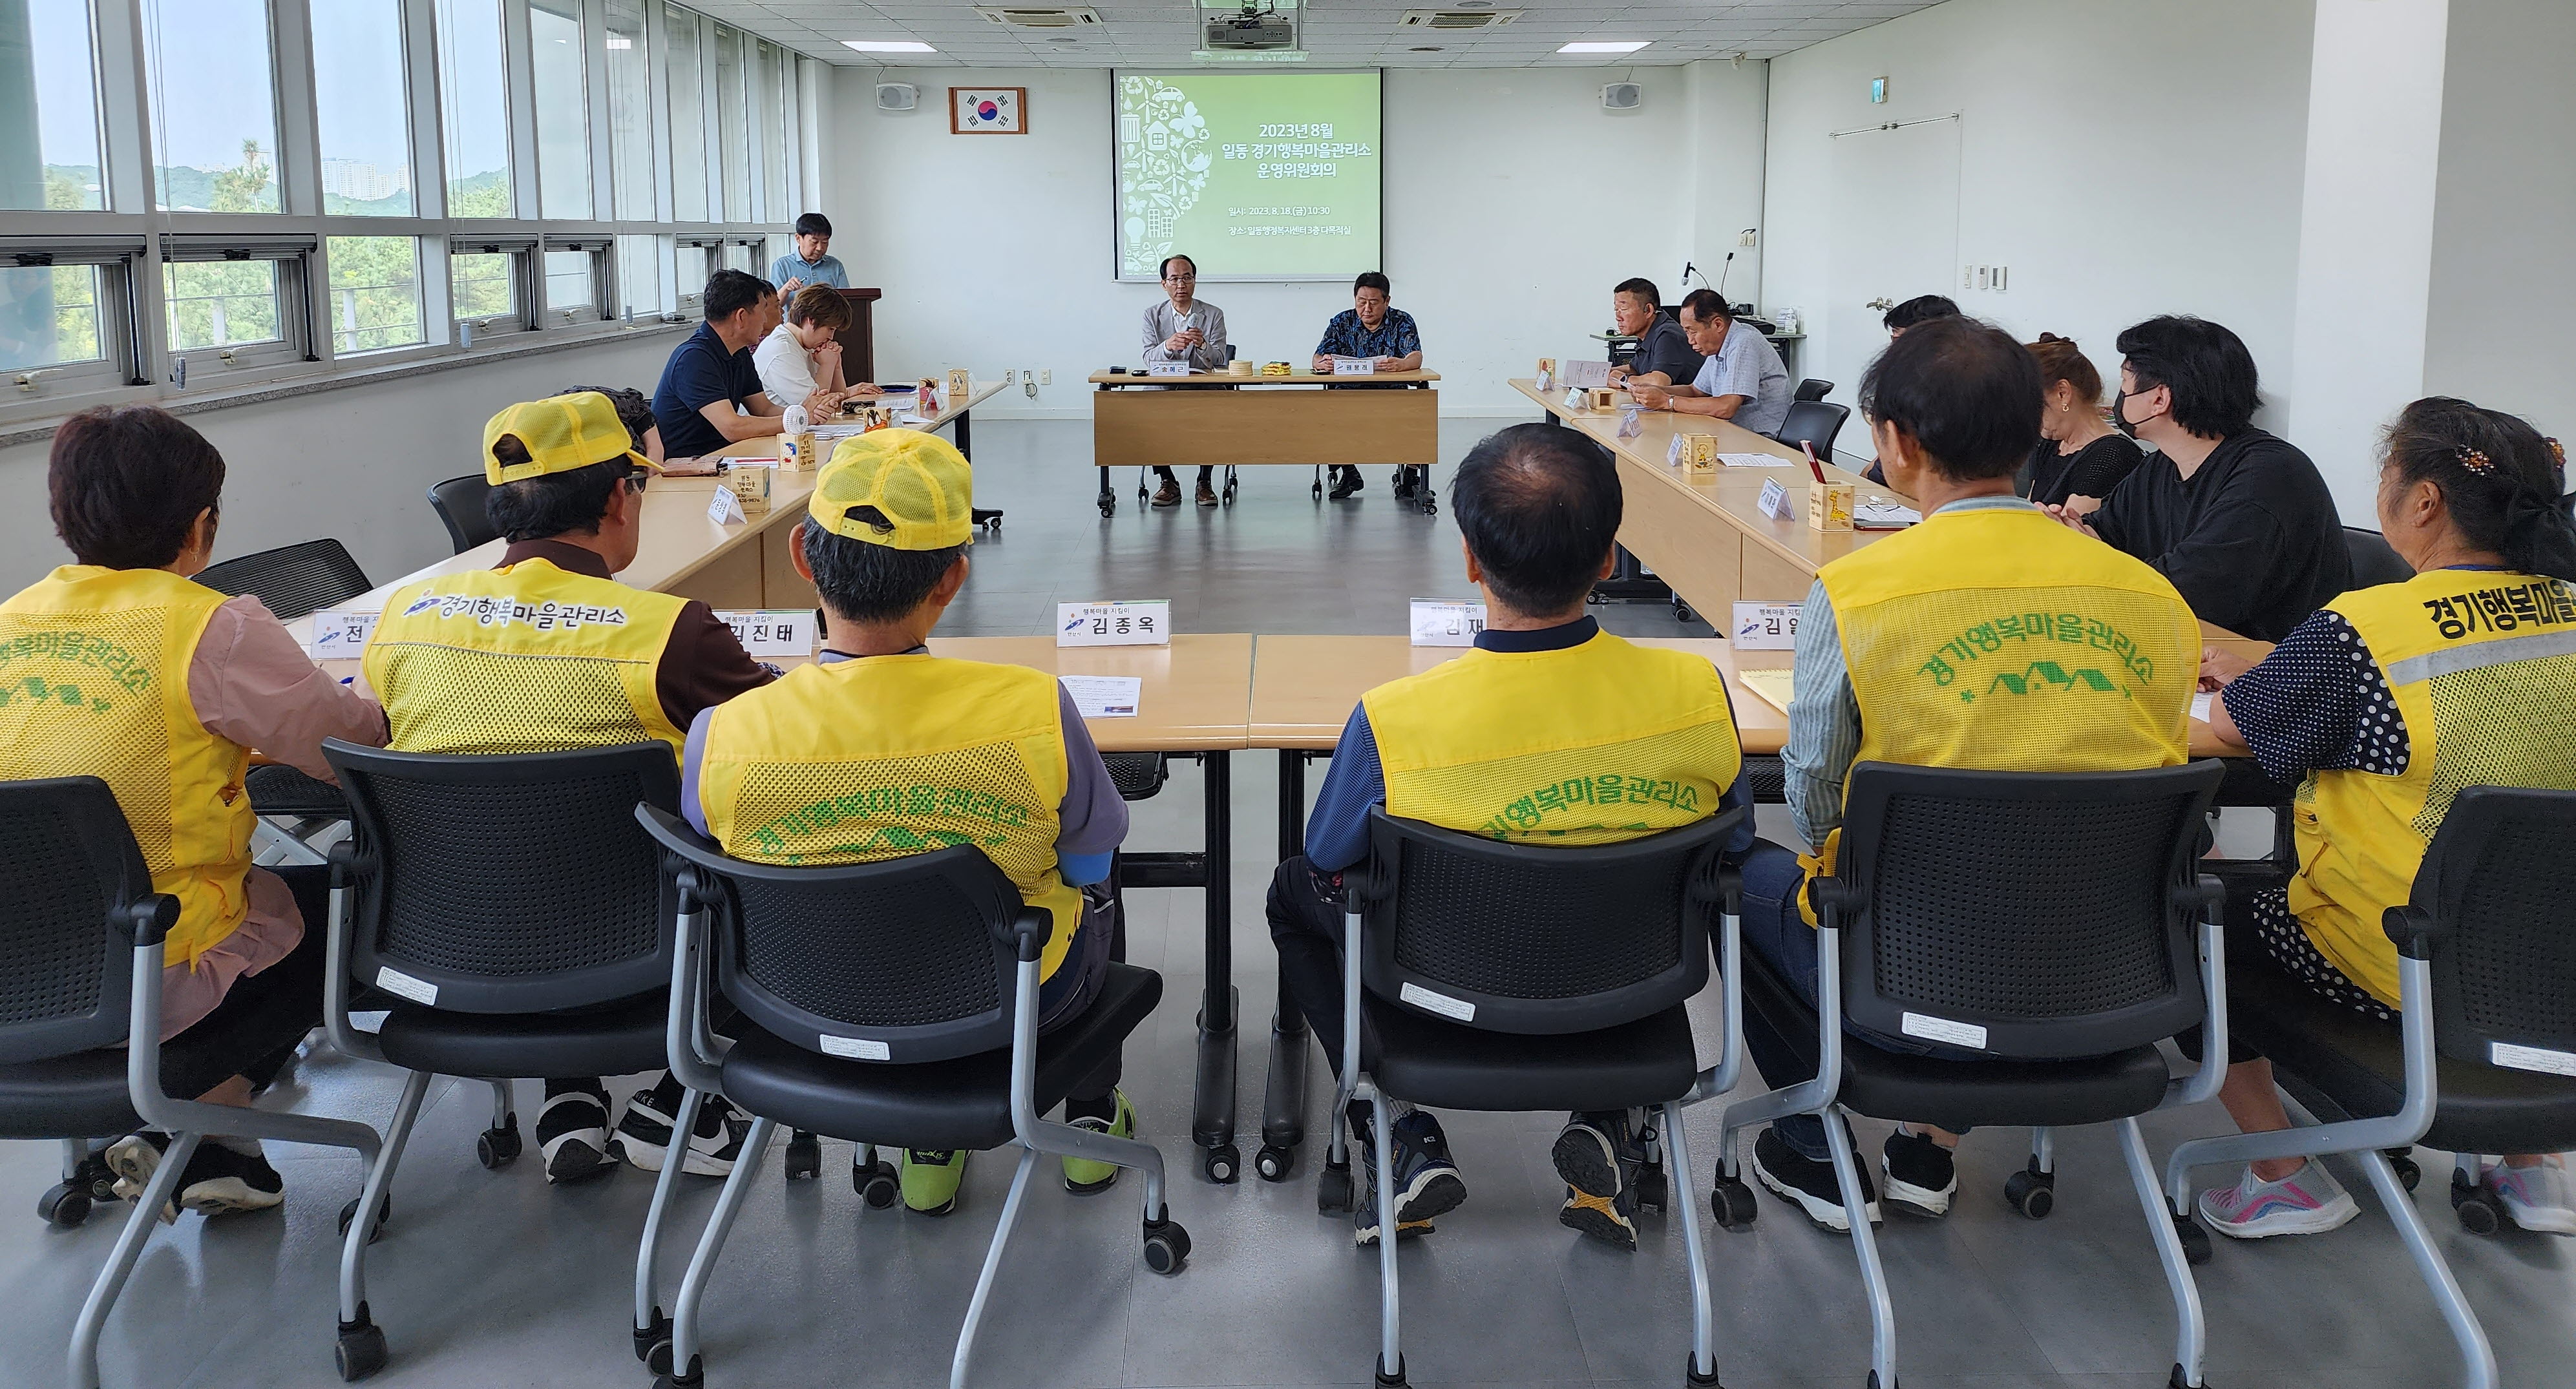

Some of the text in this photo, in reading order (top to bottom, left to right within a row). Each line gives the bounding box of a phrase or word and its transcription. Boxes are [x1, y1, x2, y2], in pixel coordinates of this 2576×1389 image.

[1258, 123, 1333, 140] 2023년 8월
[1221, 143, 1372, 160] 일동 경기행복마을관리소
[1256, 163, 1337, 180] 운영위원회의
[441, 593, 626, 629] 경기행복마을관리소
[730, 624, 793, 642] 김진태
[1092, 616, 1154, 635] 김종옥
